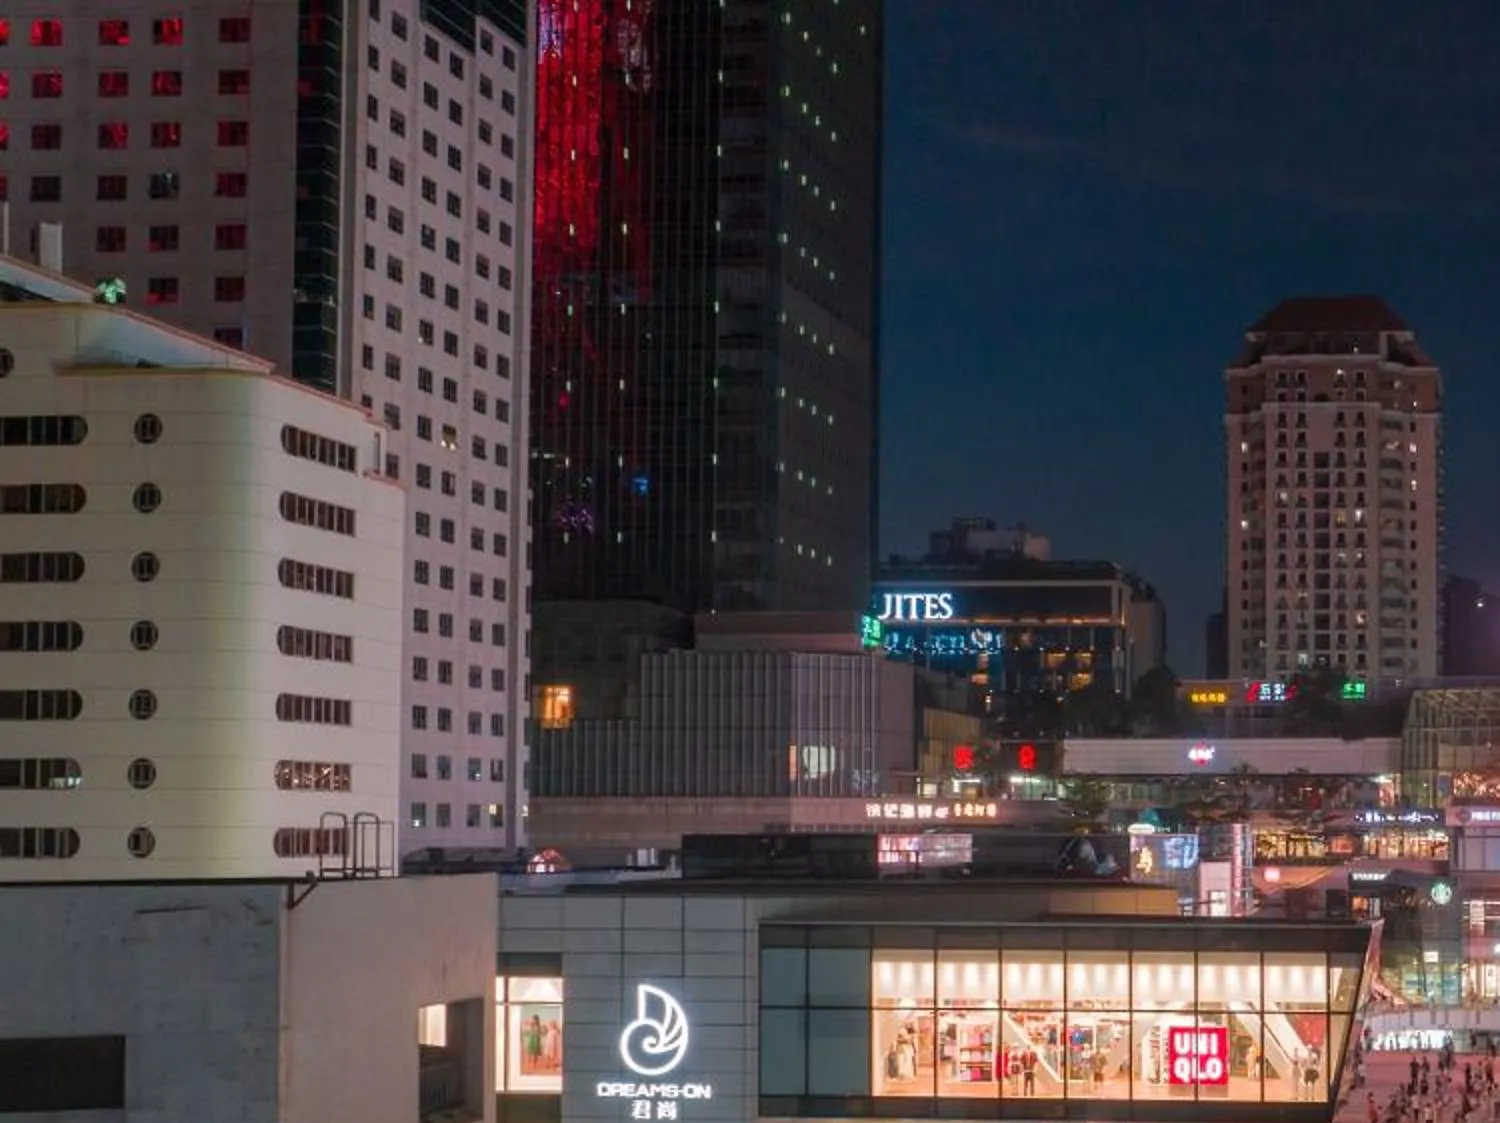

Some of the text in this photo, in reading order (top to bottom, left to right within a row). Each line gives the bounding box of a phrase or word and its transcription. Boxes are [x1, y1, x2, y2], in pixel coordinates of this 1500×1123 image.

[878, 592, 954, 620] JITES
[1173, 1031, 1219, 1054] UNI
[1173, 1058, 1223, 1083] QLO
